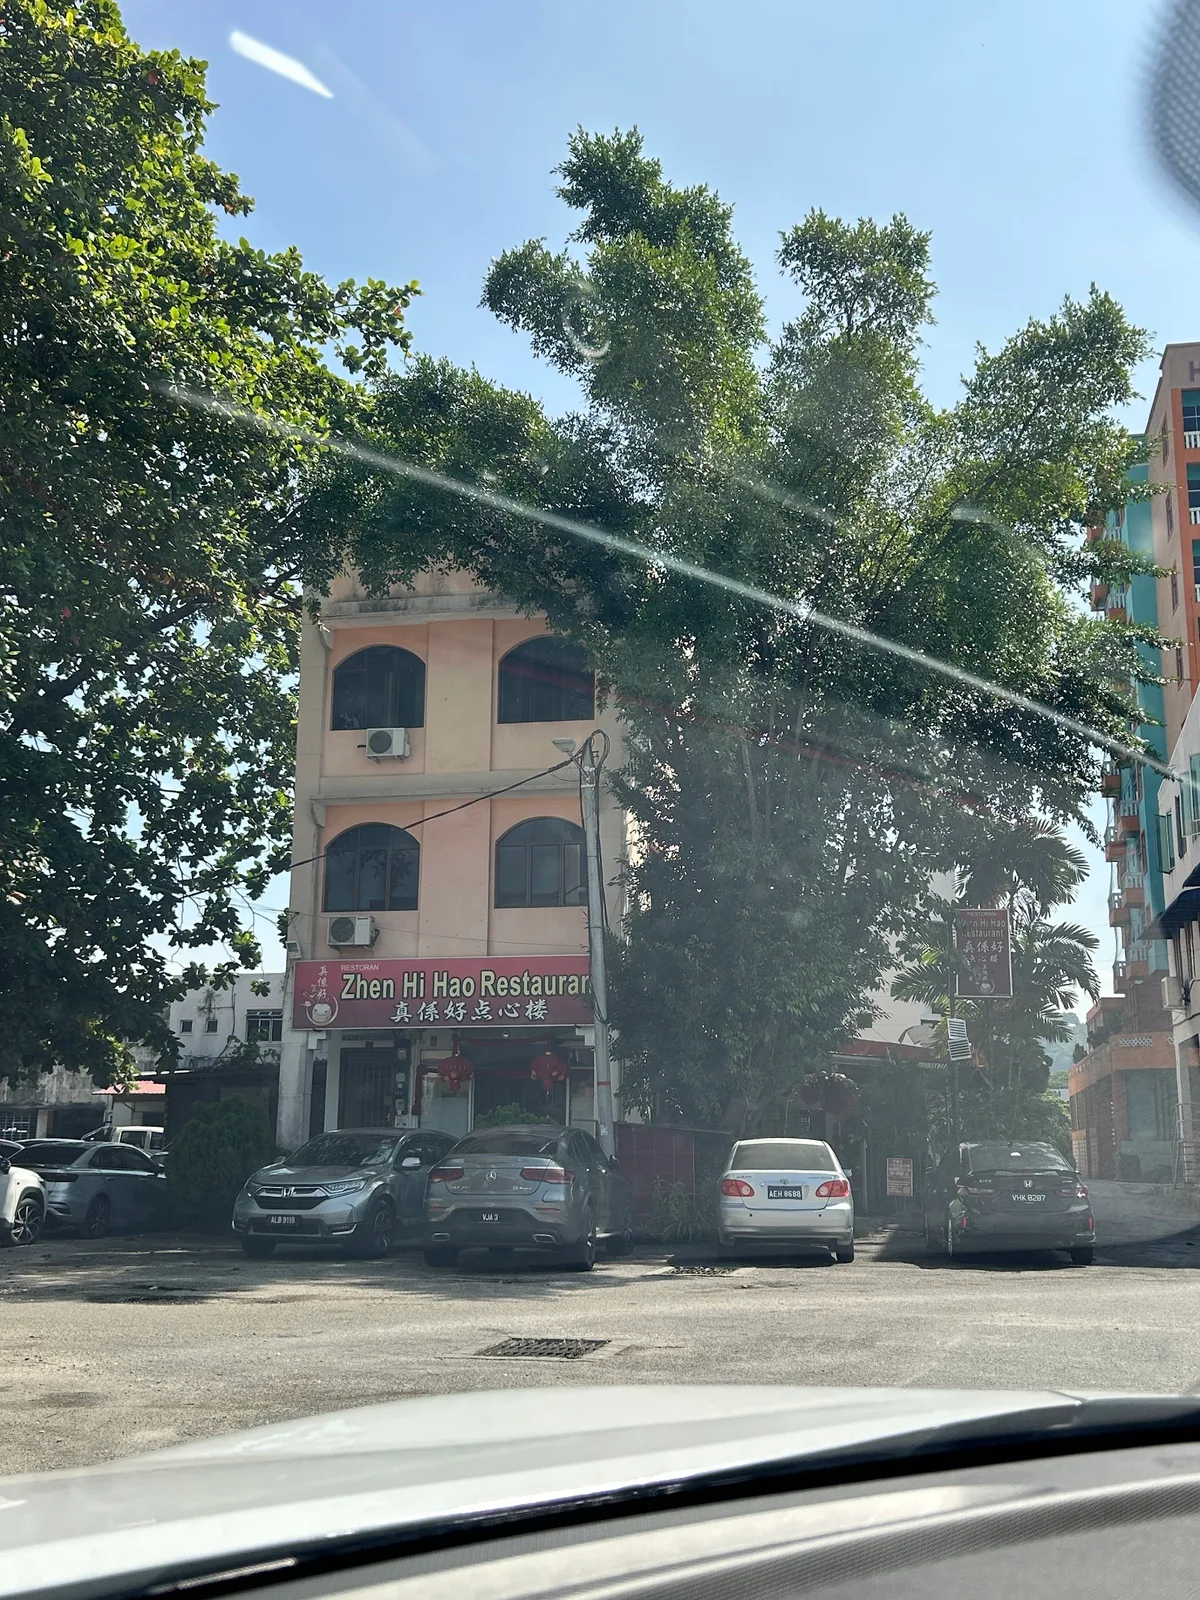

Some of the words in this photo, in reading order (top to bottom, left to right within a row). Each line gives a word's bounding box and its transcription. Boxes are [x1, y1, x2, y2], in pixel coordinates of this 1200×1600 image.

[980, 919, 988, 928] Hi
[990, 919, 1006, 928] Hao
[340, 973, 395, 999] Zhen
[402, 971, 425, 998] Hi
[433, 971, 475, 998] Hao
[480, 970, 592, 997] Restauran
[769, 1190, 783, 1198] AEH
[1012, 1194, 1027, 1202] VHK
[482, 1213, 493, 1221] VJA
[494, 1213, 499, 1221] 3
